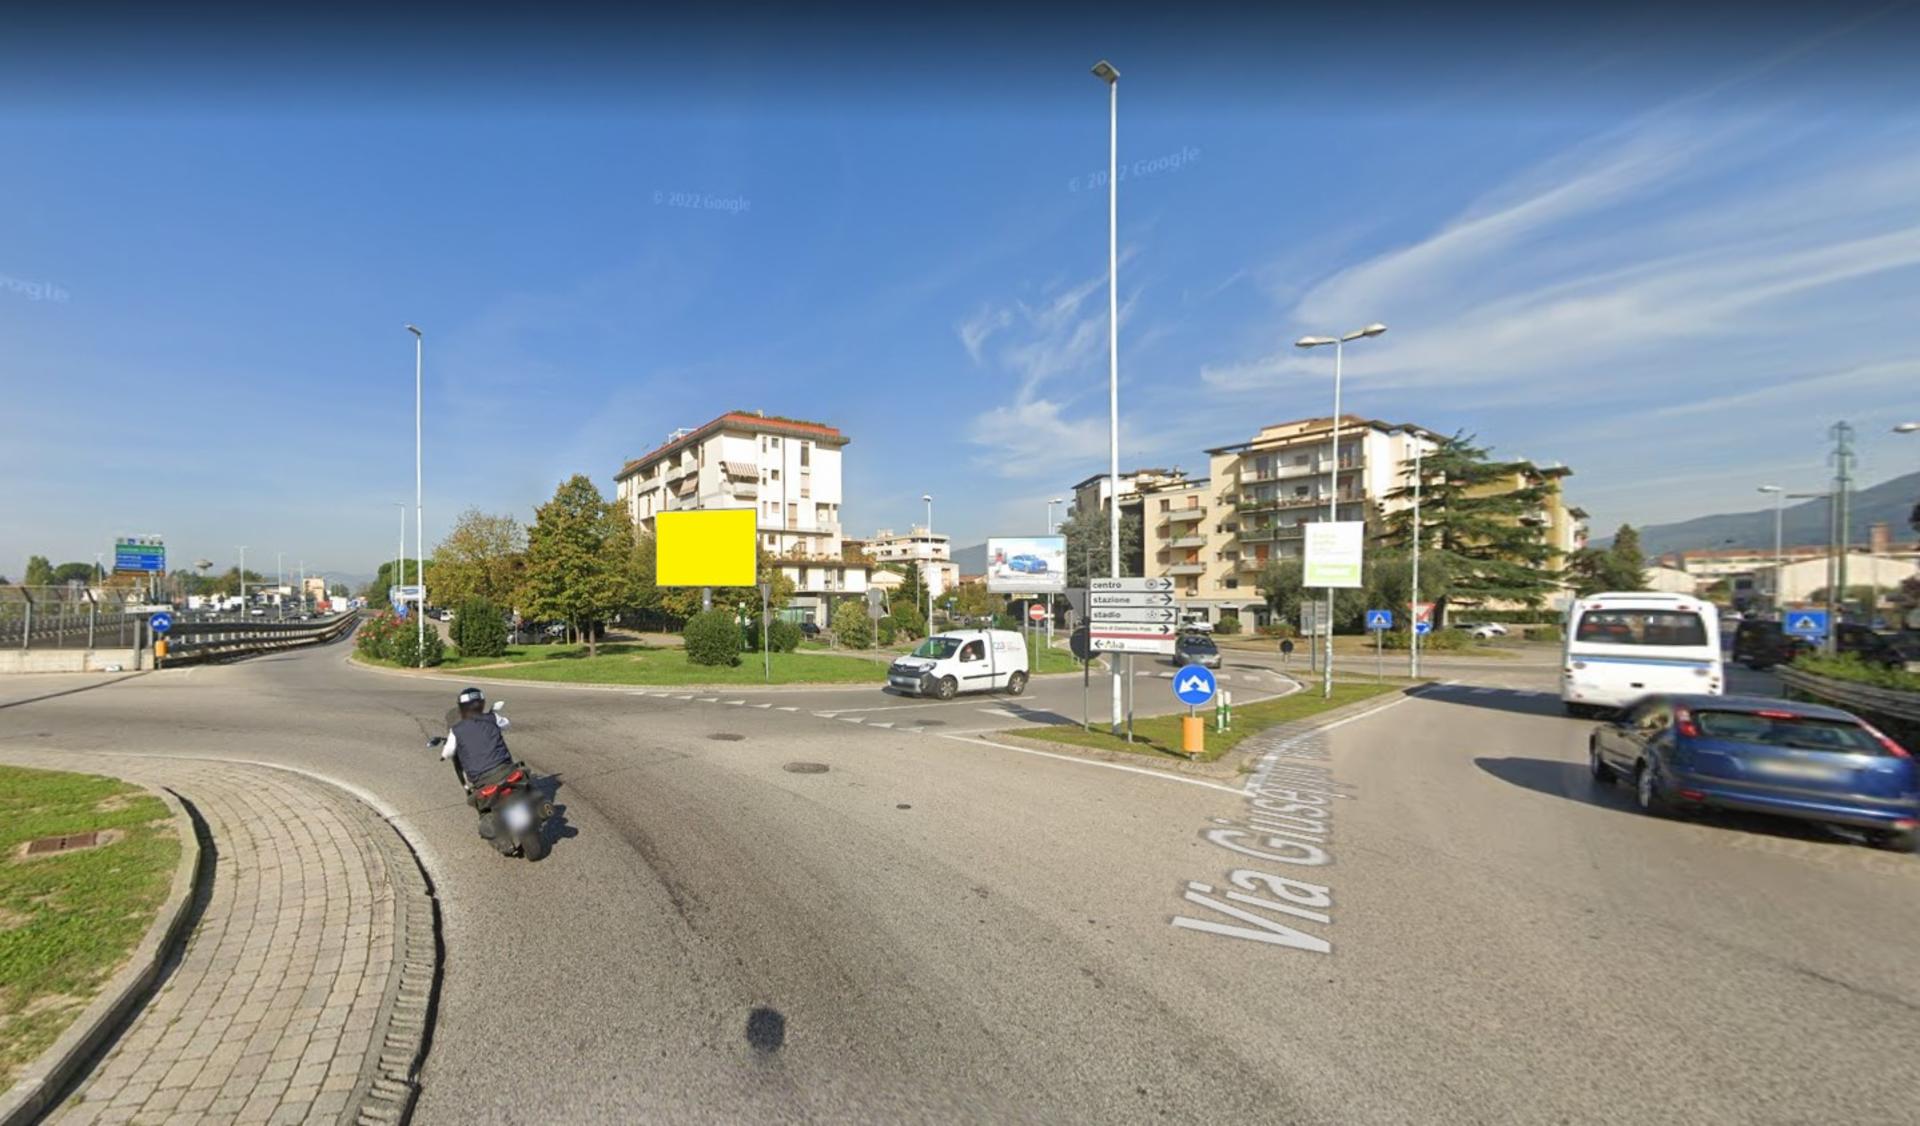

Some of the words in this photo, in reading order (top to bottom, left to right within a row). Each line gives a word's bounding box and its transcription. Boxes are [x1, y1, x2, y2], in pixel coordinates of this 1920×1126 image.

[1092, 580, 1122, 589] centro
[1093, 595, 1131, 604] stazione
[1093, 610, 1121, 619] stadio
